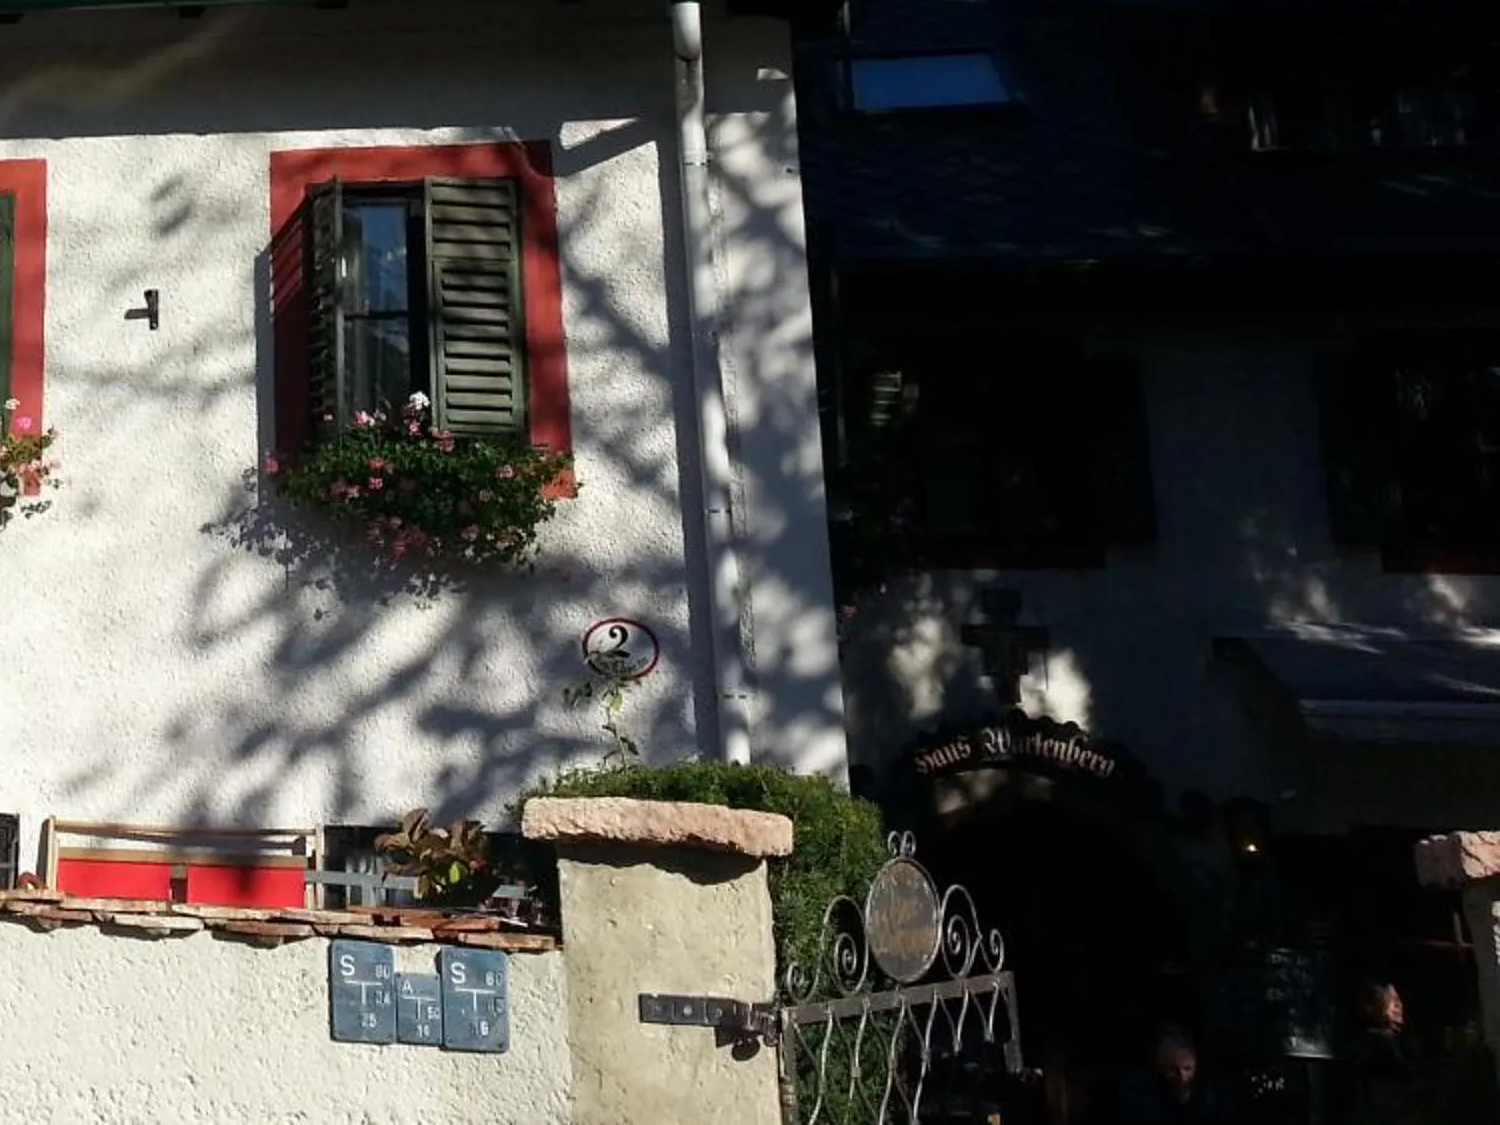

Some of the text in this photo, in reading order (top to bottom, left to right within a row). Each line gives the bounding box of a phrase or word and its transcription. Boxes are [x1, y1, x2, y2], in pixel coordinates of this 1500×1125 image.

[605, 625, 631, 658] 2
[340, 954, 355, 976] S
[451, 962, 466, 984] S
[403, 979, 413, 993] A
